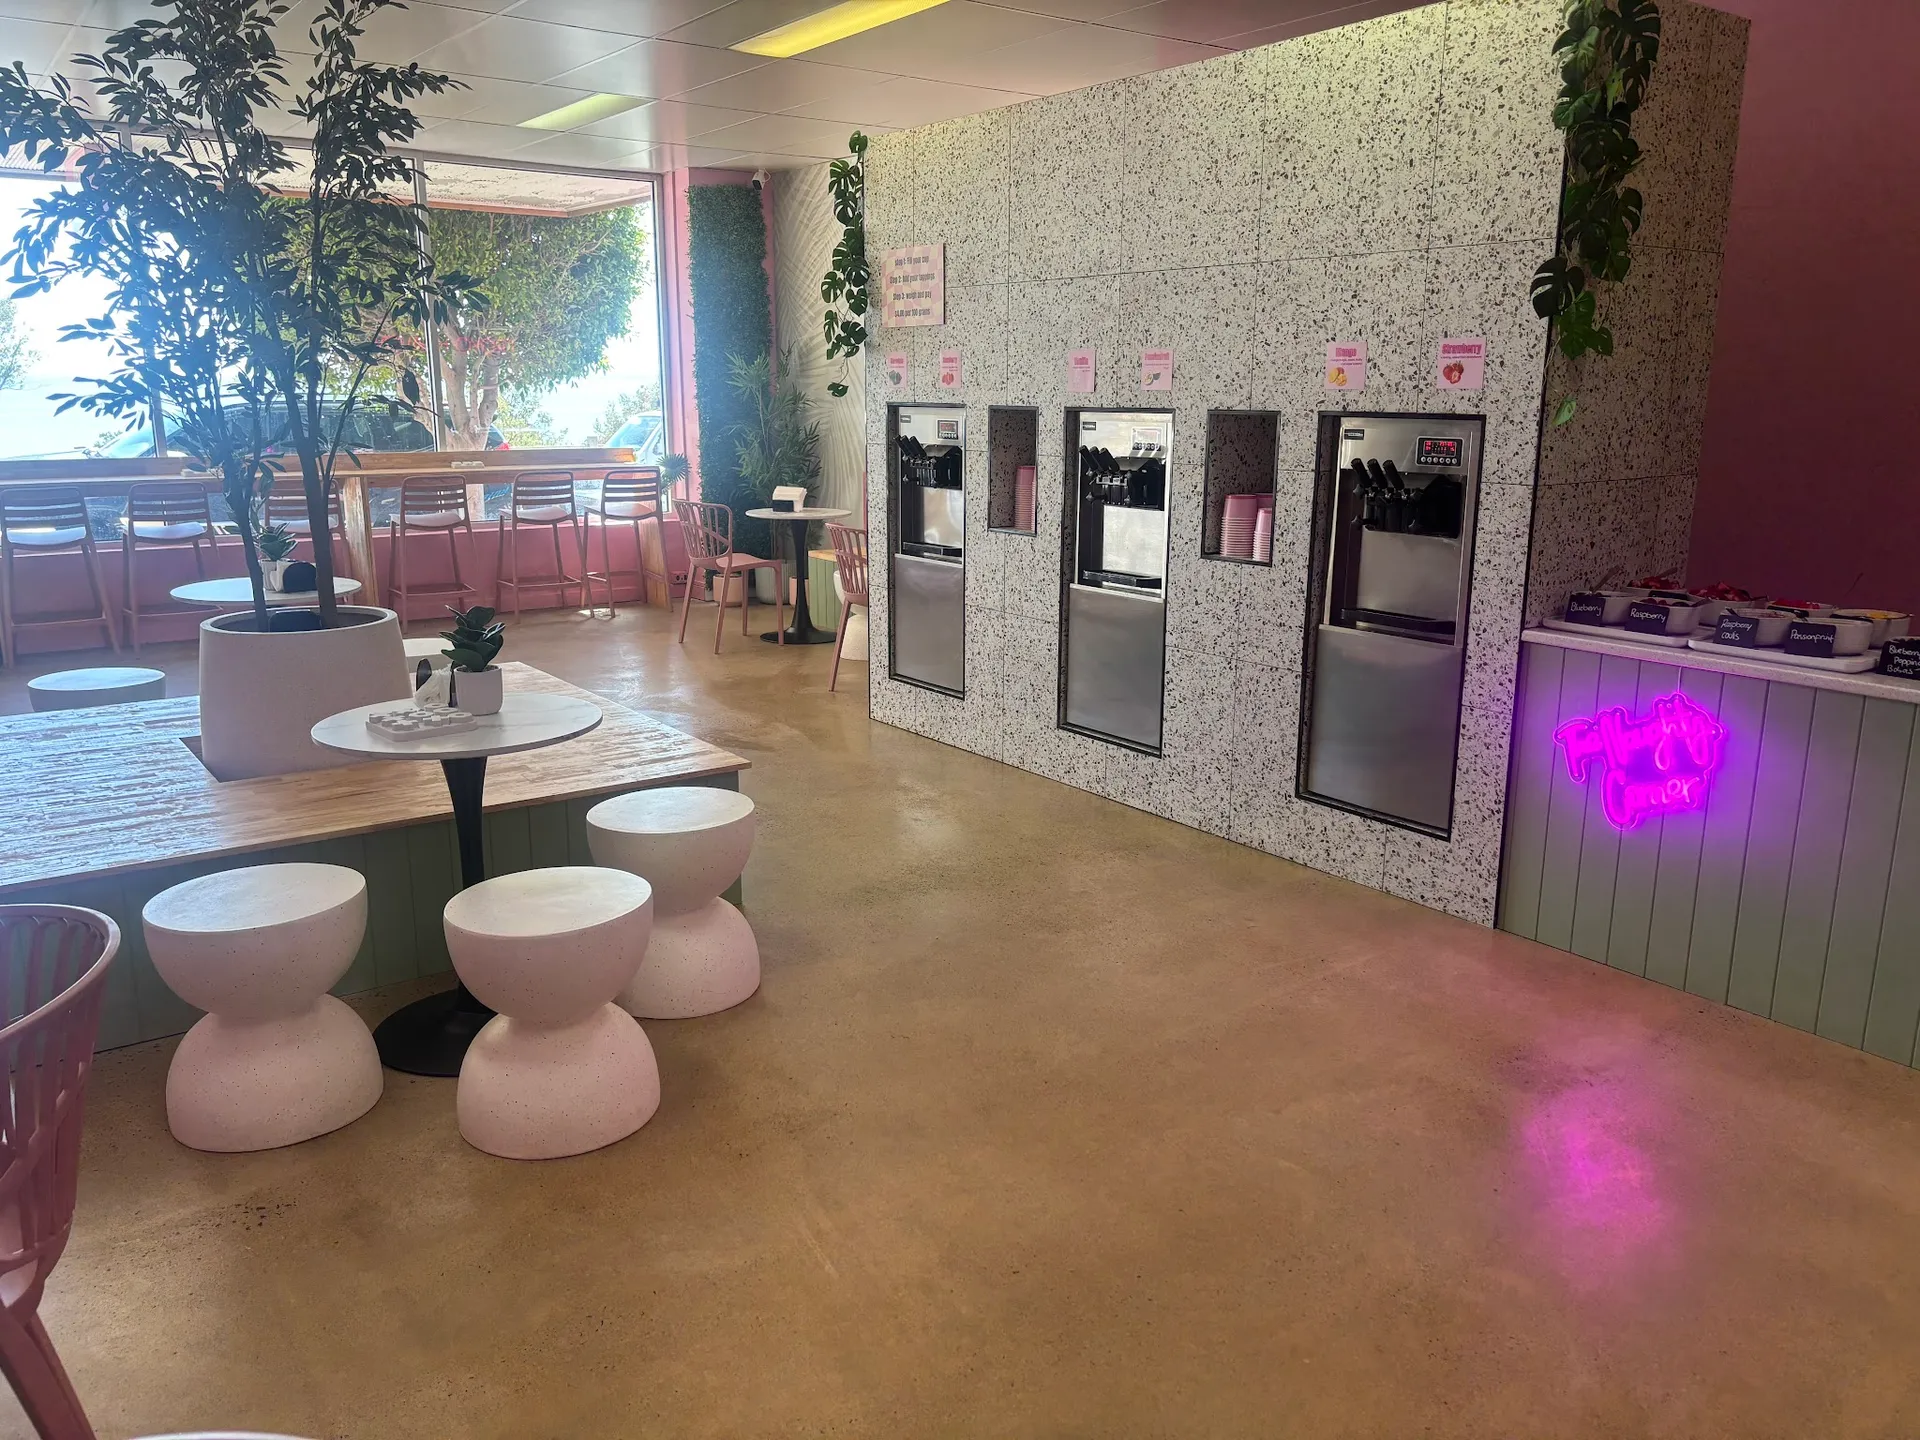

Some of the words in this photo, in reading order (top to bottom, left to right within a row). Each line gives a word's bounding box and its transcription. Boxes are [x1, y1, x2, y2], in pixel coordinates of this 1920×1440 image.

[1570, 602, 1602, 616] Blueberry
[1630, 608, 1666, 623] Raspberry
[1606, 769, 1700, 824] Corner
